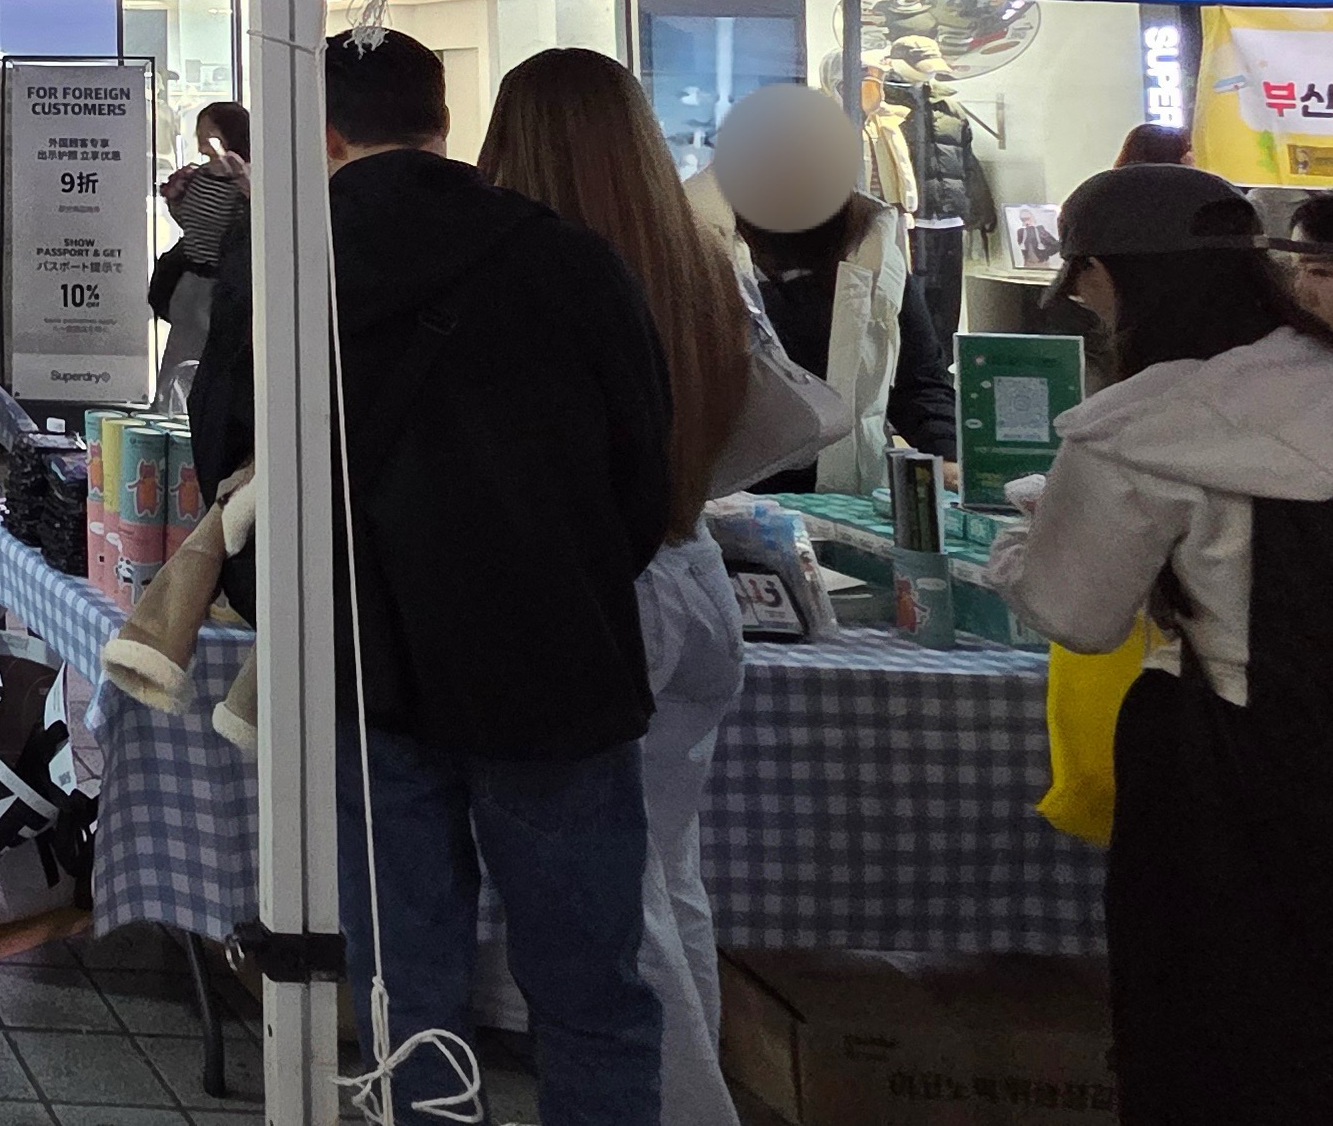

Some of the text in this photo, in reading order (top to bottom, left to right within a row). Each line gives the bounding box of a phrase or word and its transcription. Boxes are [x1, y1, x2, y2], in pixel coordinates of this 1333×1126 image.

[27, 87, 130, 100] FOR FOREIGN
[31, 102, 126, 115] CUSTOMERS
[60, 172, 99, 194] 9折
[64, 238, 95, 247] SHOW
[36, 248, 89, 257] PASSPORT
[103, 248, 122, 257] GET
[60, 284, 100, 308] 10%
